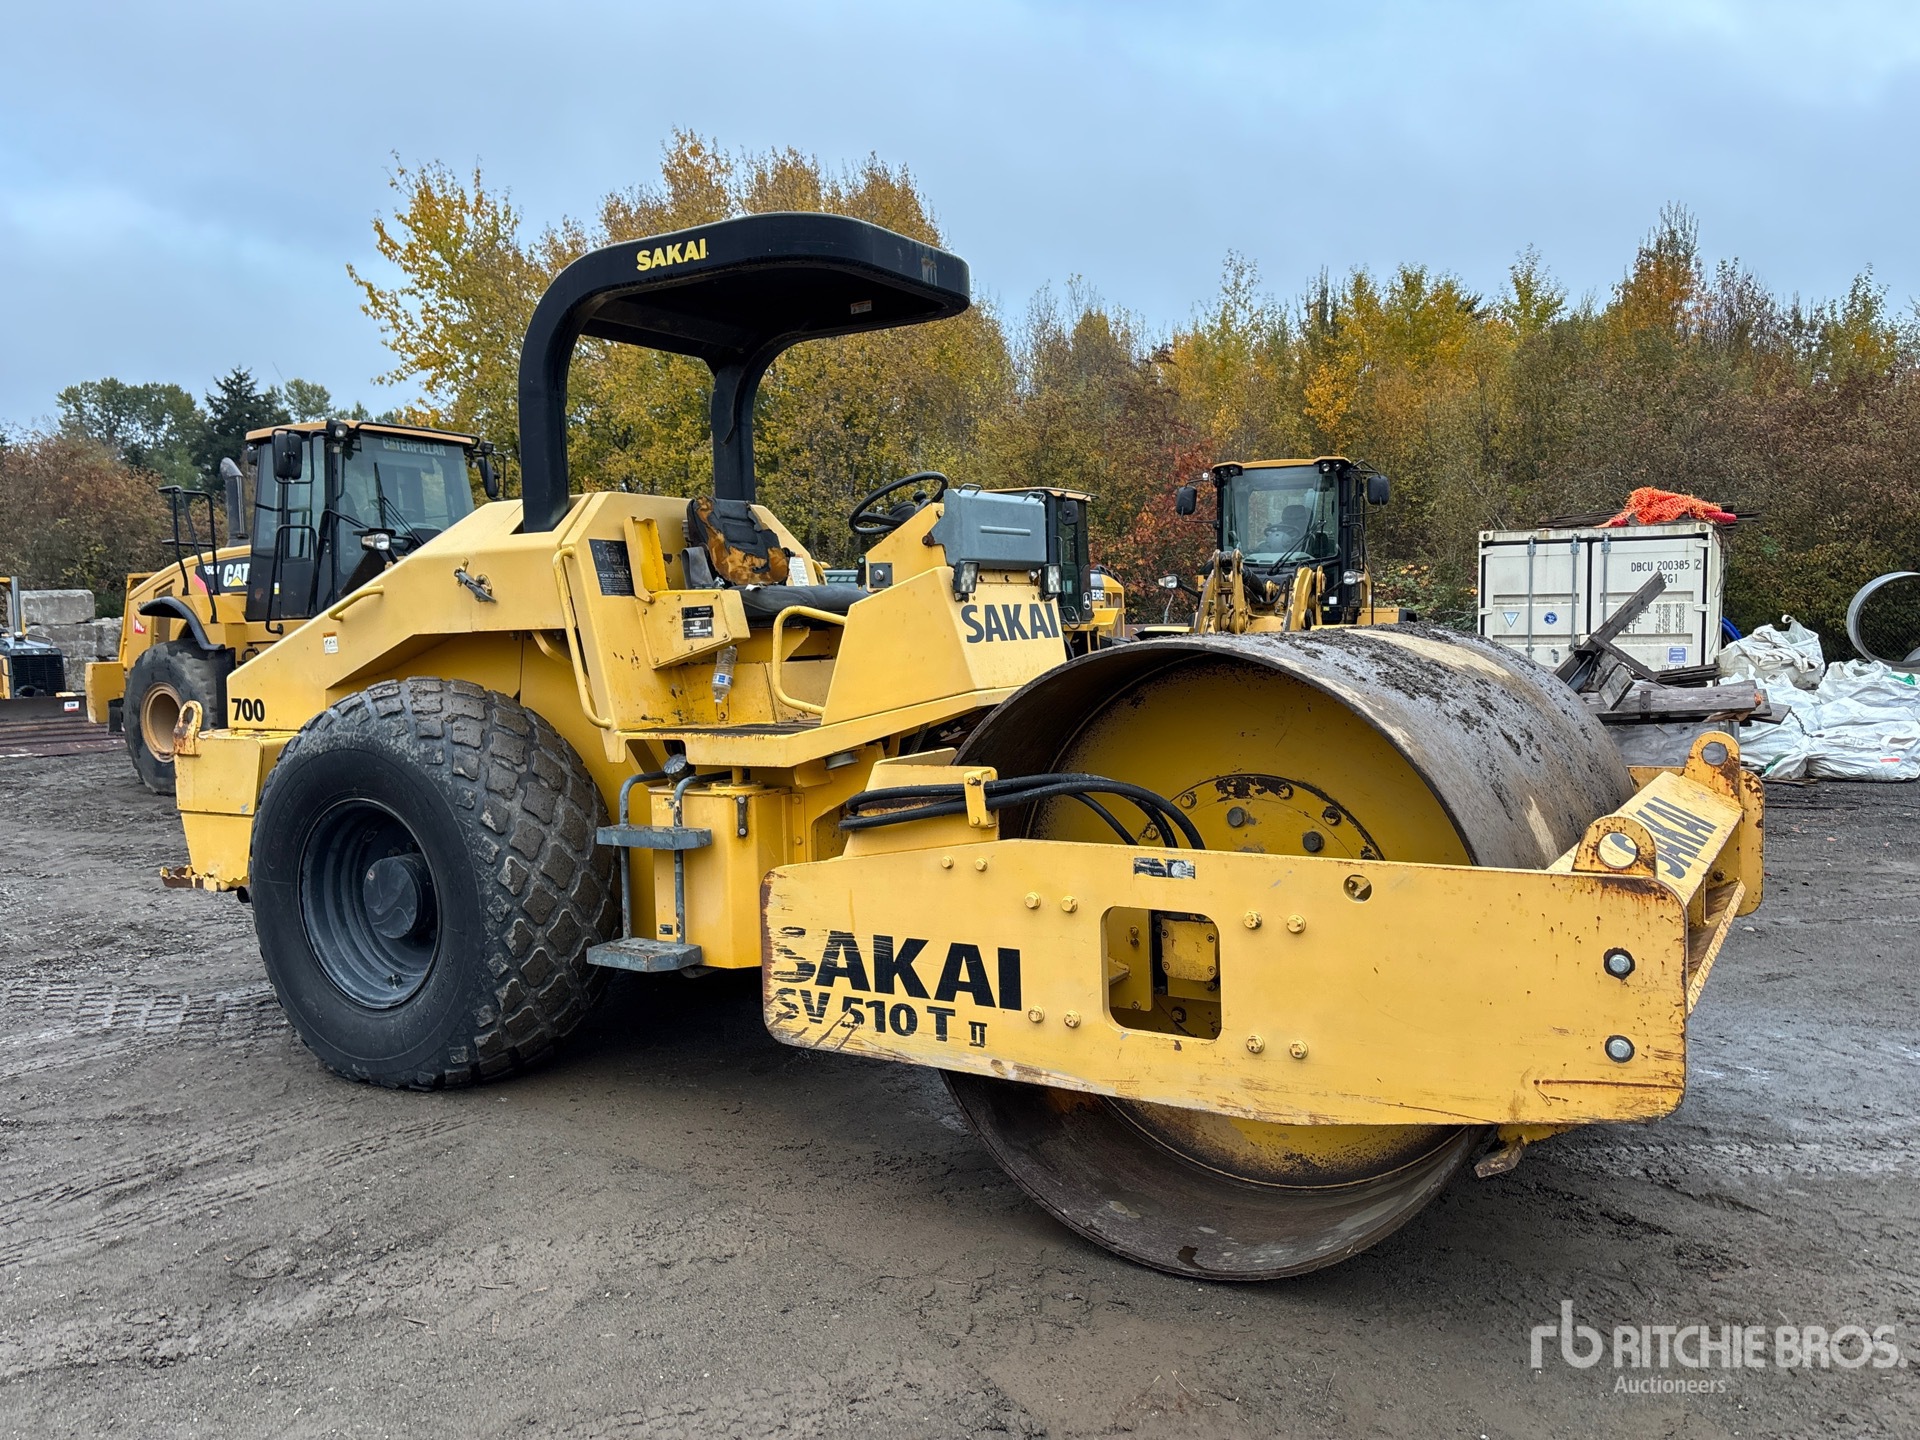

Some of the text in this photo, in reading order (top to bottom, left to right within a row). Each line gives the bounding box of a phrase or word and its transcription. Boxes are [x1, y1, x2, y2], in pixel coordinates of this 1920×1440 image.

[636, 238, 706, 271] SAKAI
[382, 437, 446, 456] CATERPILLAR
[223, 563, 250, 587] CAT
[1631, 559, 1701, 572] DBCU 200385 2
[1663, 574, 1678, 583] 2G1
[1091, 589, 1104, 601] ERE
[960, 603, 1060, 643] SAKAI
[231, 698, 265, 722] 700
[773, 926, 1022, 1011] SAKAI
[776, 987, 831, 1024] SV
[841, 996, 918, 1036] 510
[927, 1005, 956, 1042] T
